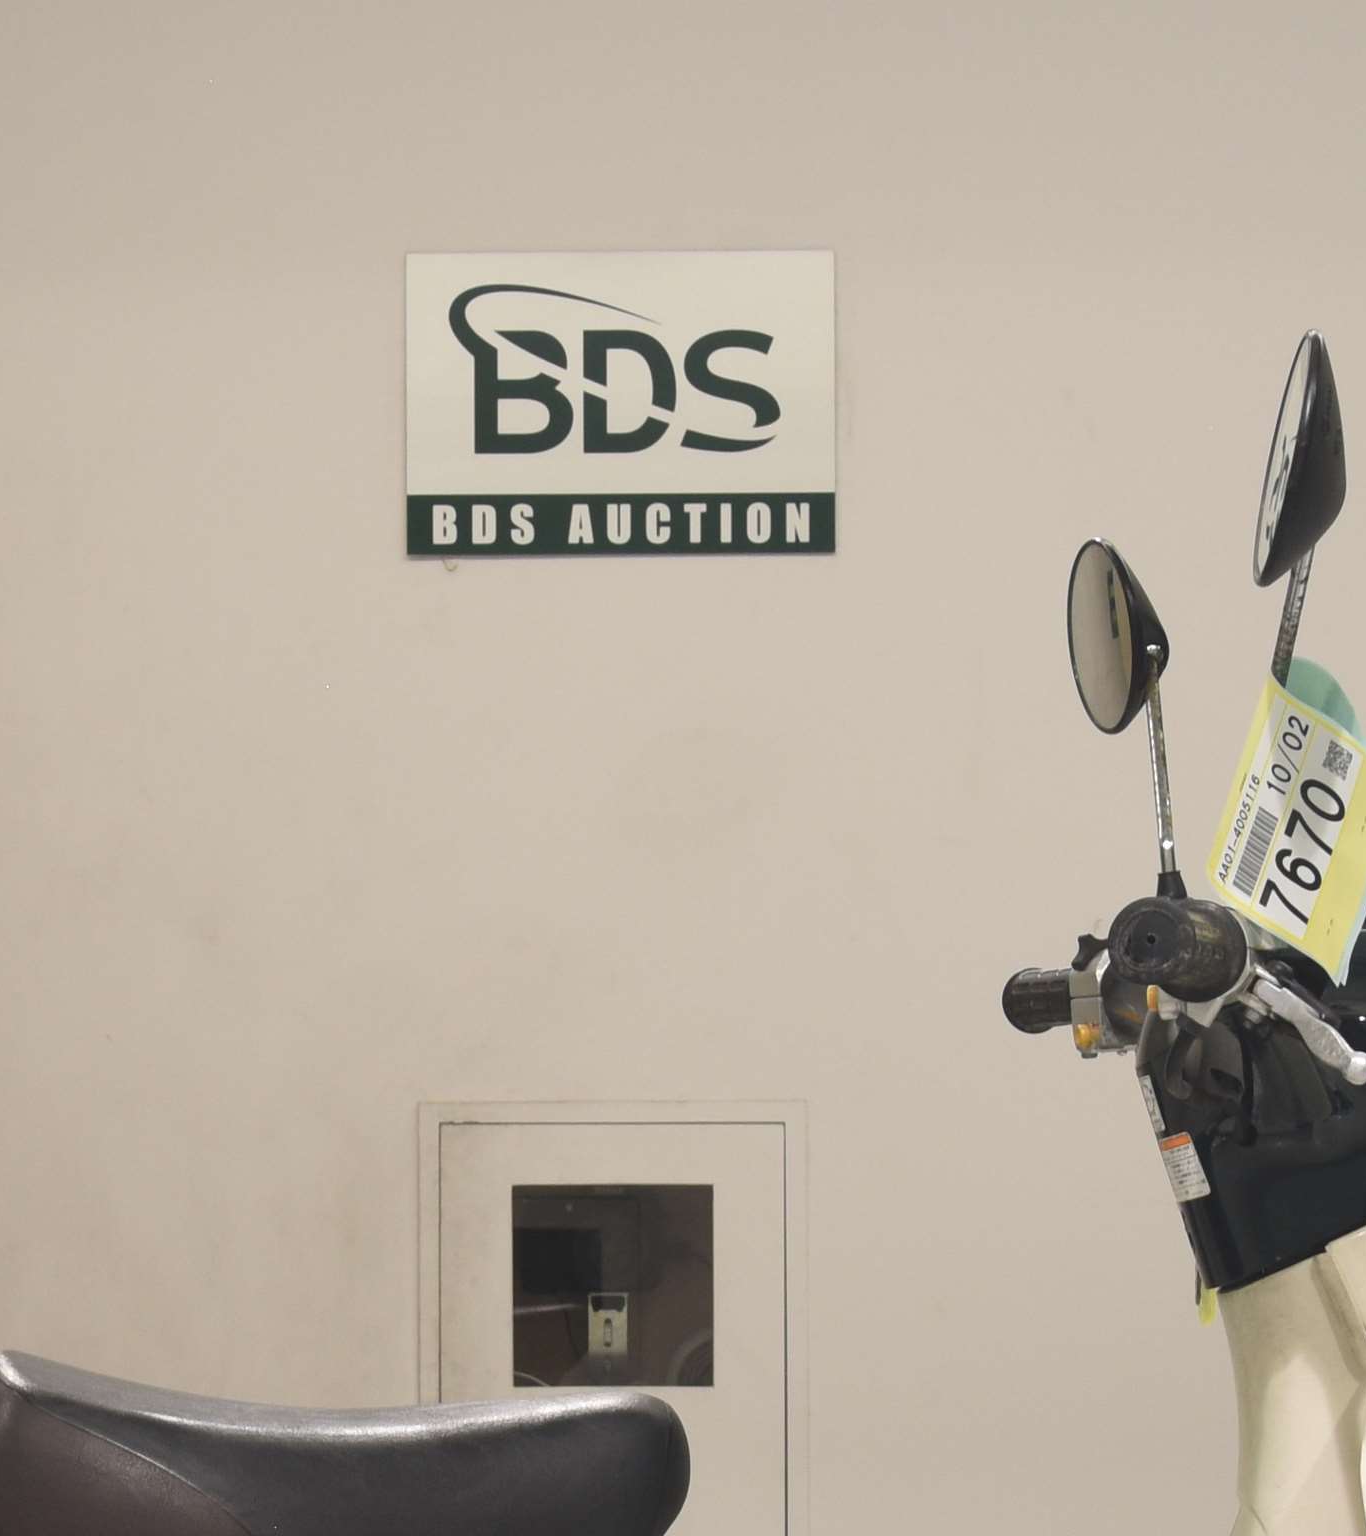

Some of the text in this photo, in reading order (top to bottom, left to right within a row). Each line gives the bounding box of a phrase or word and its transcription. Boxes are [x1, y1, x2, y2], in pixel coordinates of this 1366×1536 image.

[449, 284, 781, 454] BDS
[432, 502, 810, 545] BDS AUCTION
[1267, 714, 1309, 796] 10/02
[1259, 778, 1346, 926] 7670
